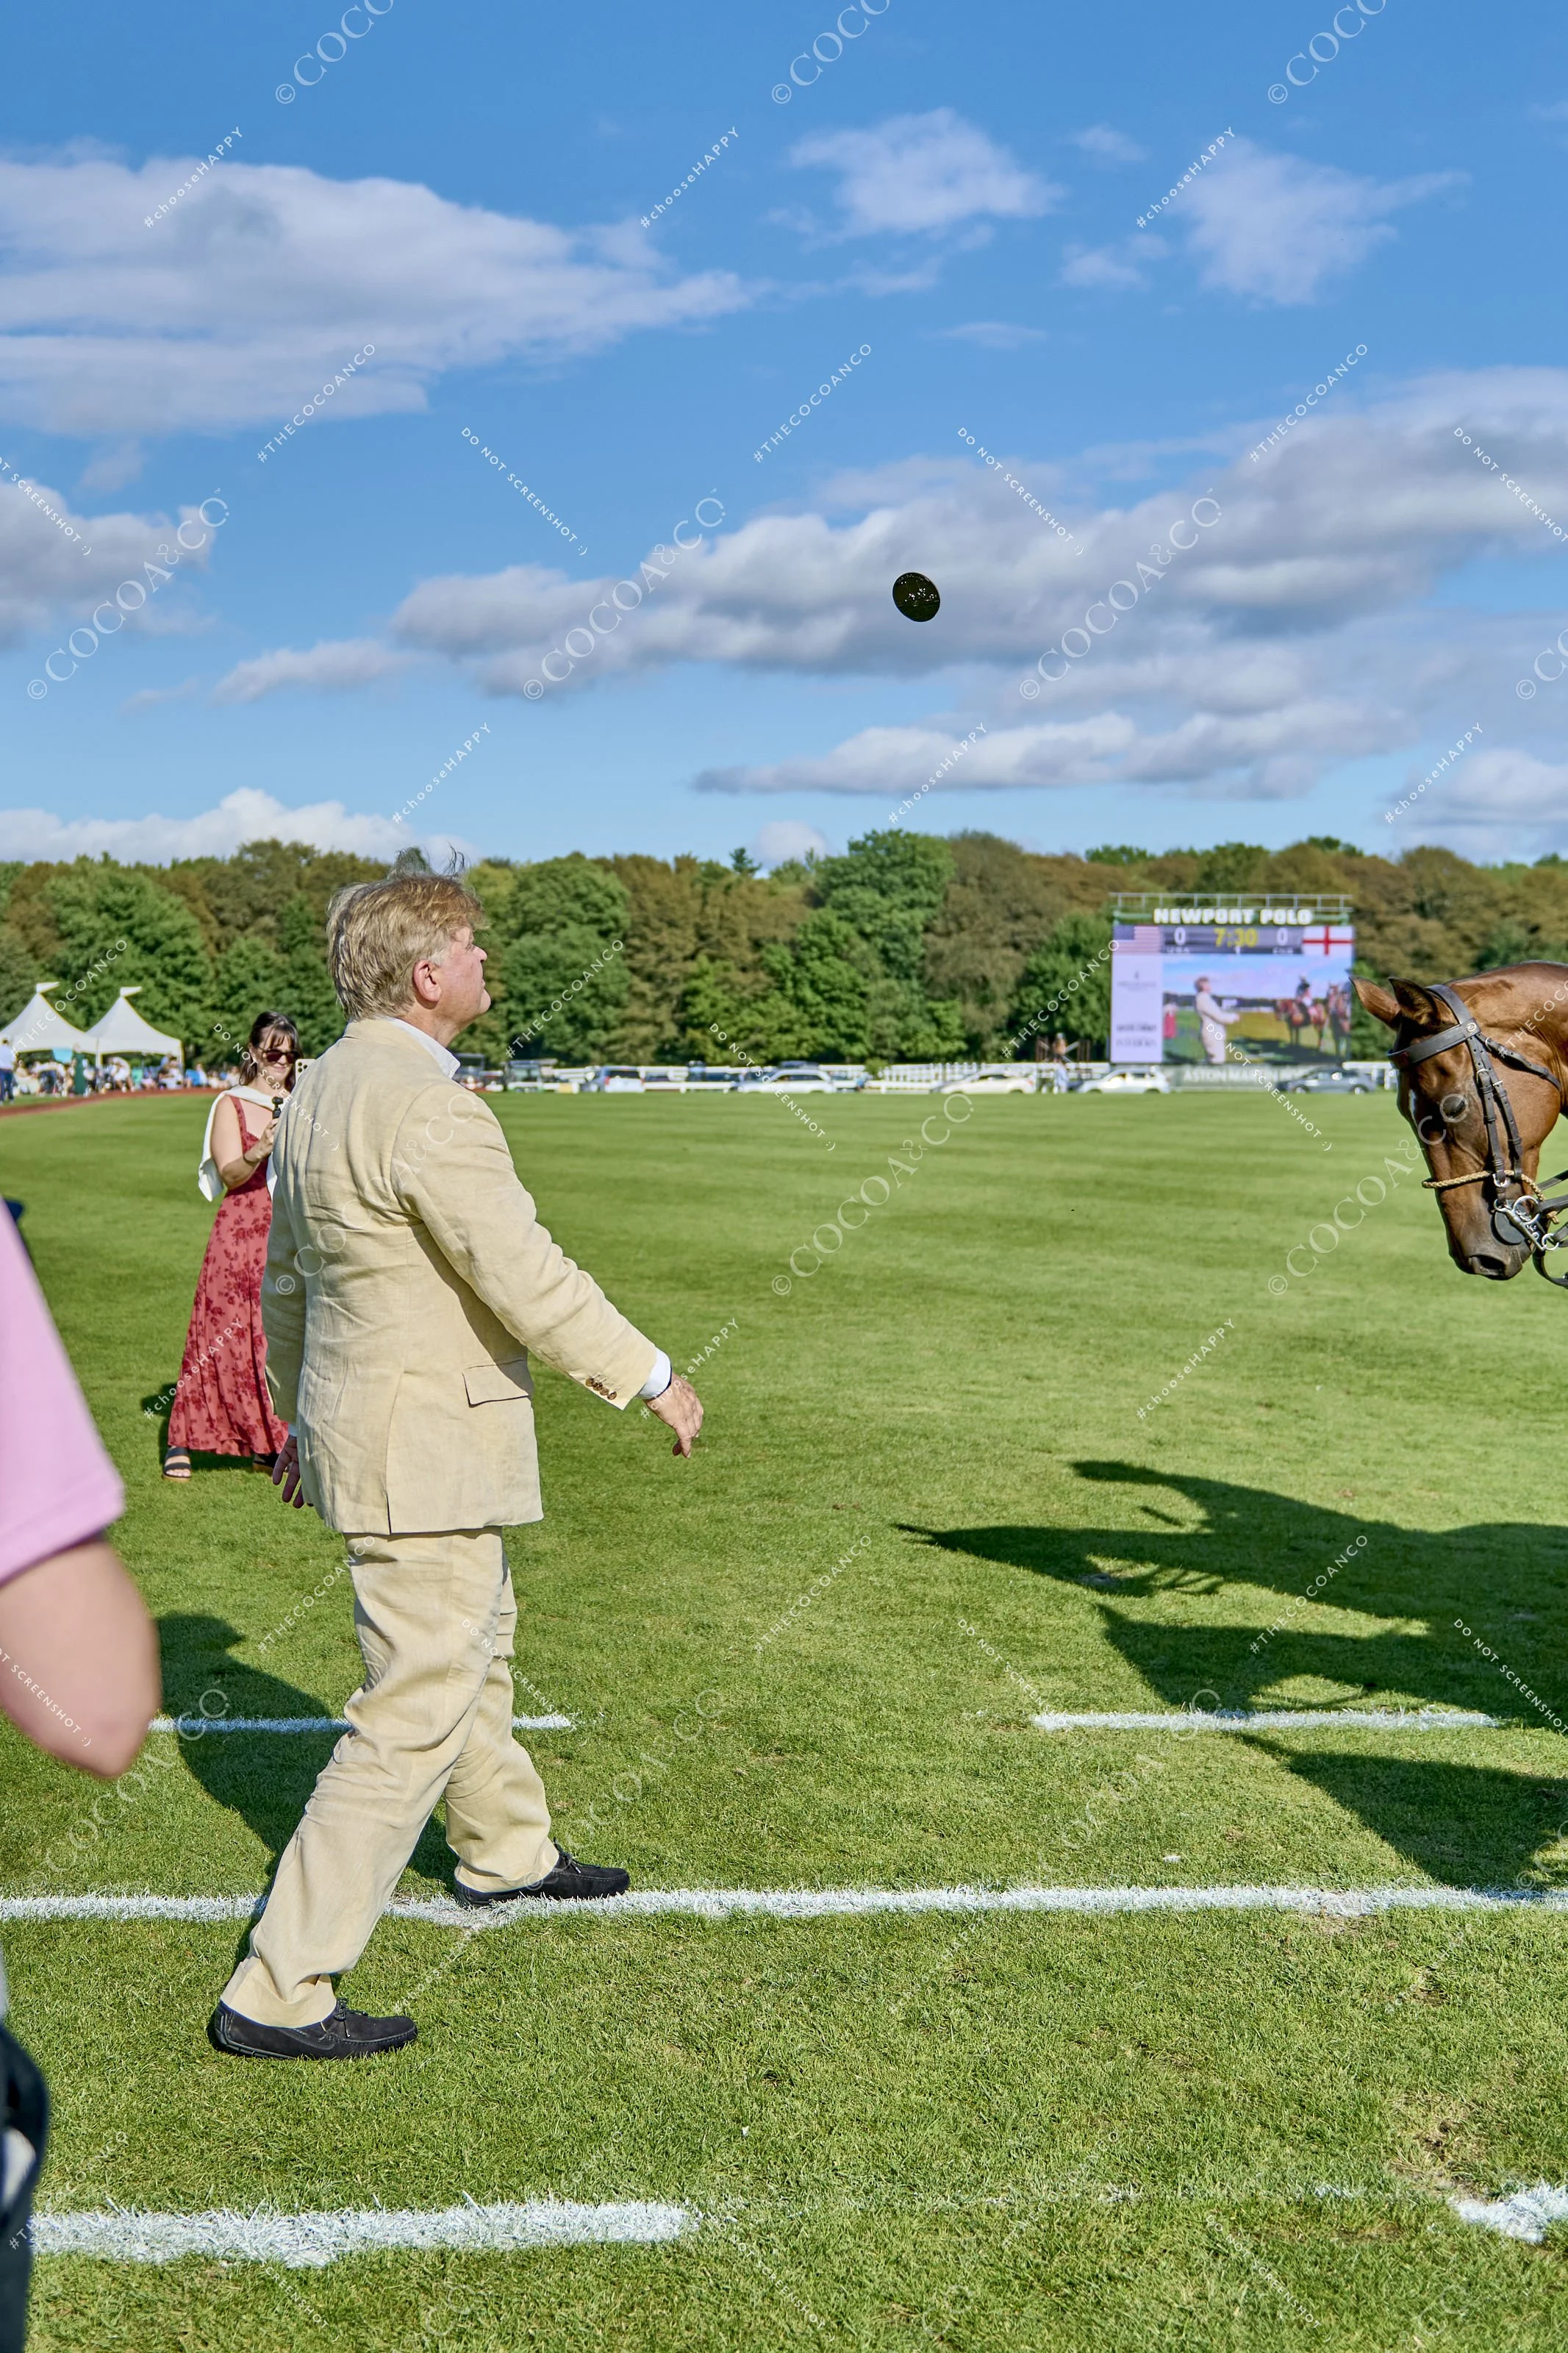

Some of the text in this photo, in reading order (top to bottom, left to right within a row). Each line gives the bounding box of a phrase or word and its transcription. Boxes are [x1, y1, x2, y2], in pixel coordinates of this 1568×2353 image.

[1153, 908, 1313, 925] NEWPORT POLO
[1174, 927, 1186, 946] 0
[1214, 927, 1258, 948] 7:30
[1276, 927, 1288, 946] 0
[1184, 1068, 1227, 1082] ASTON
[1228, 1068, 1279, 1082] MAIN
